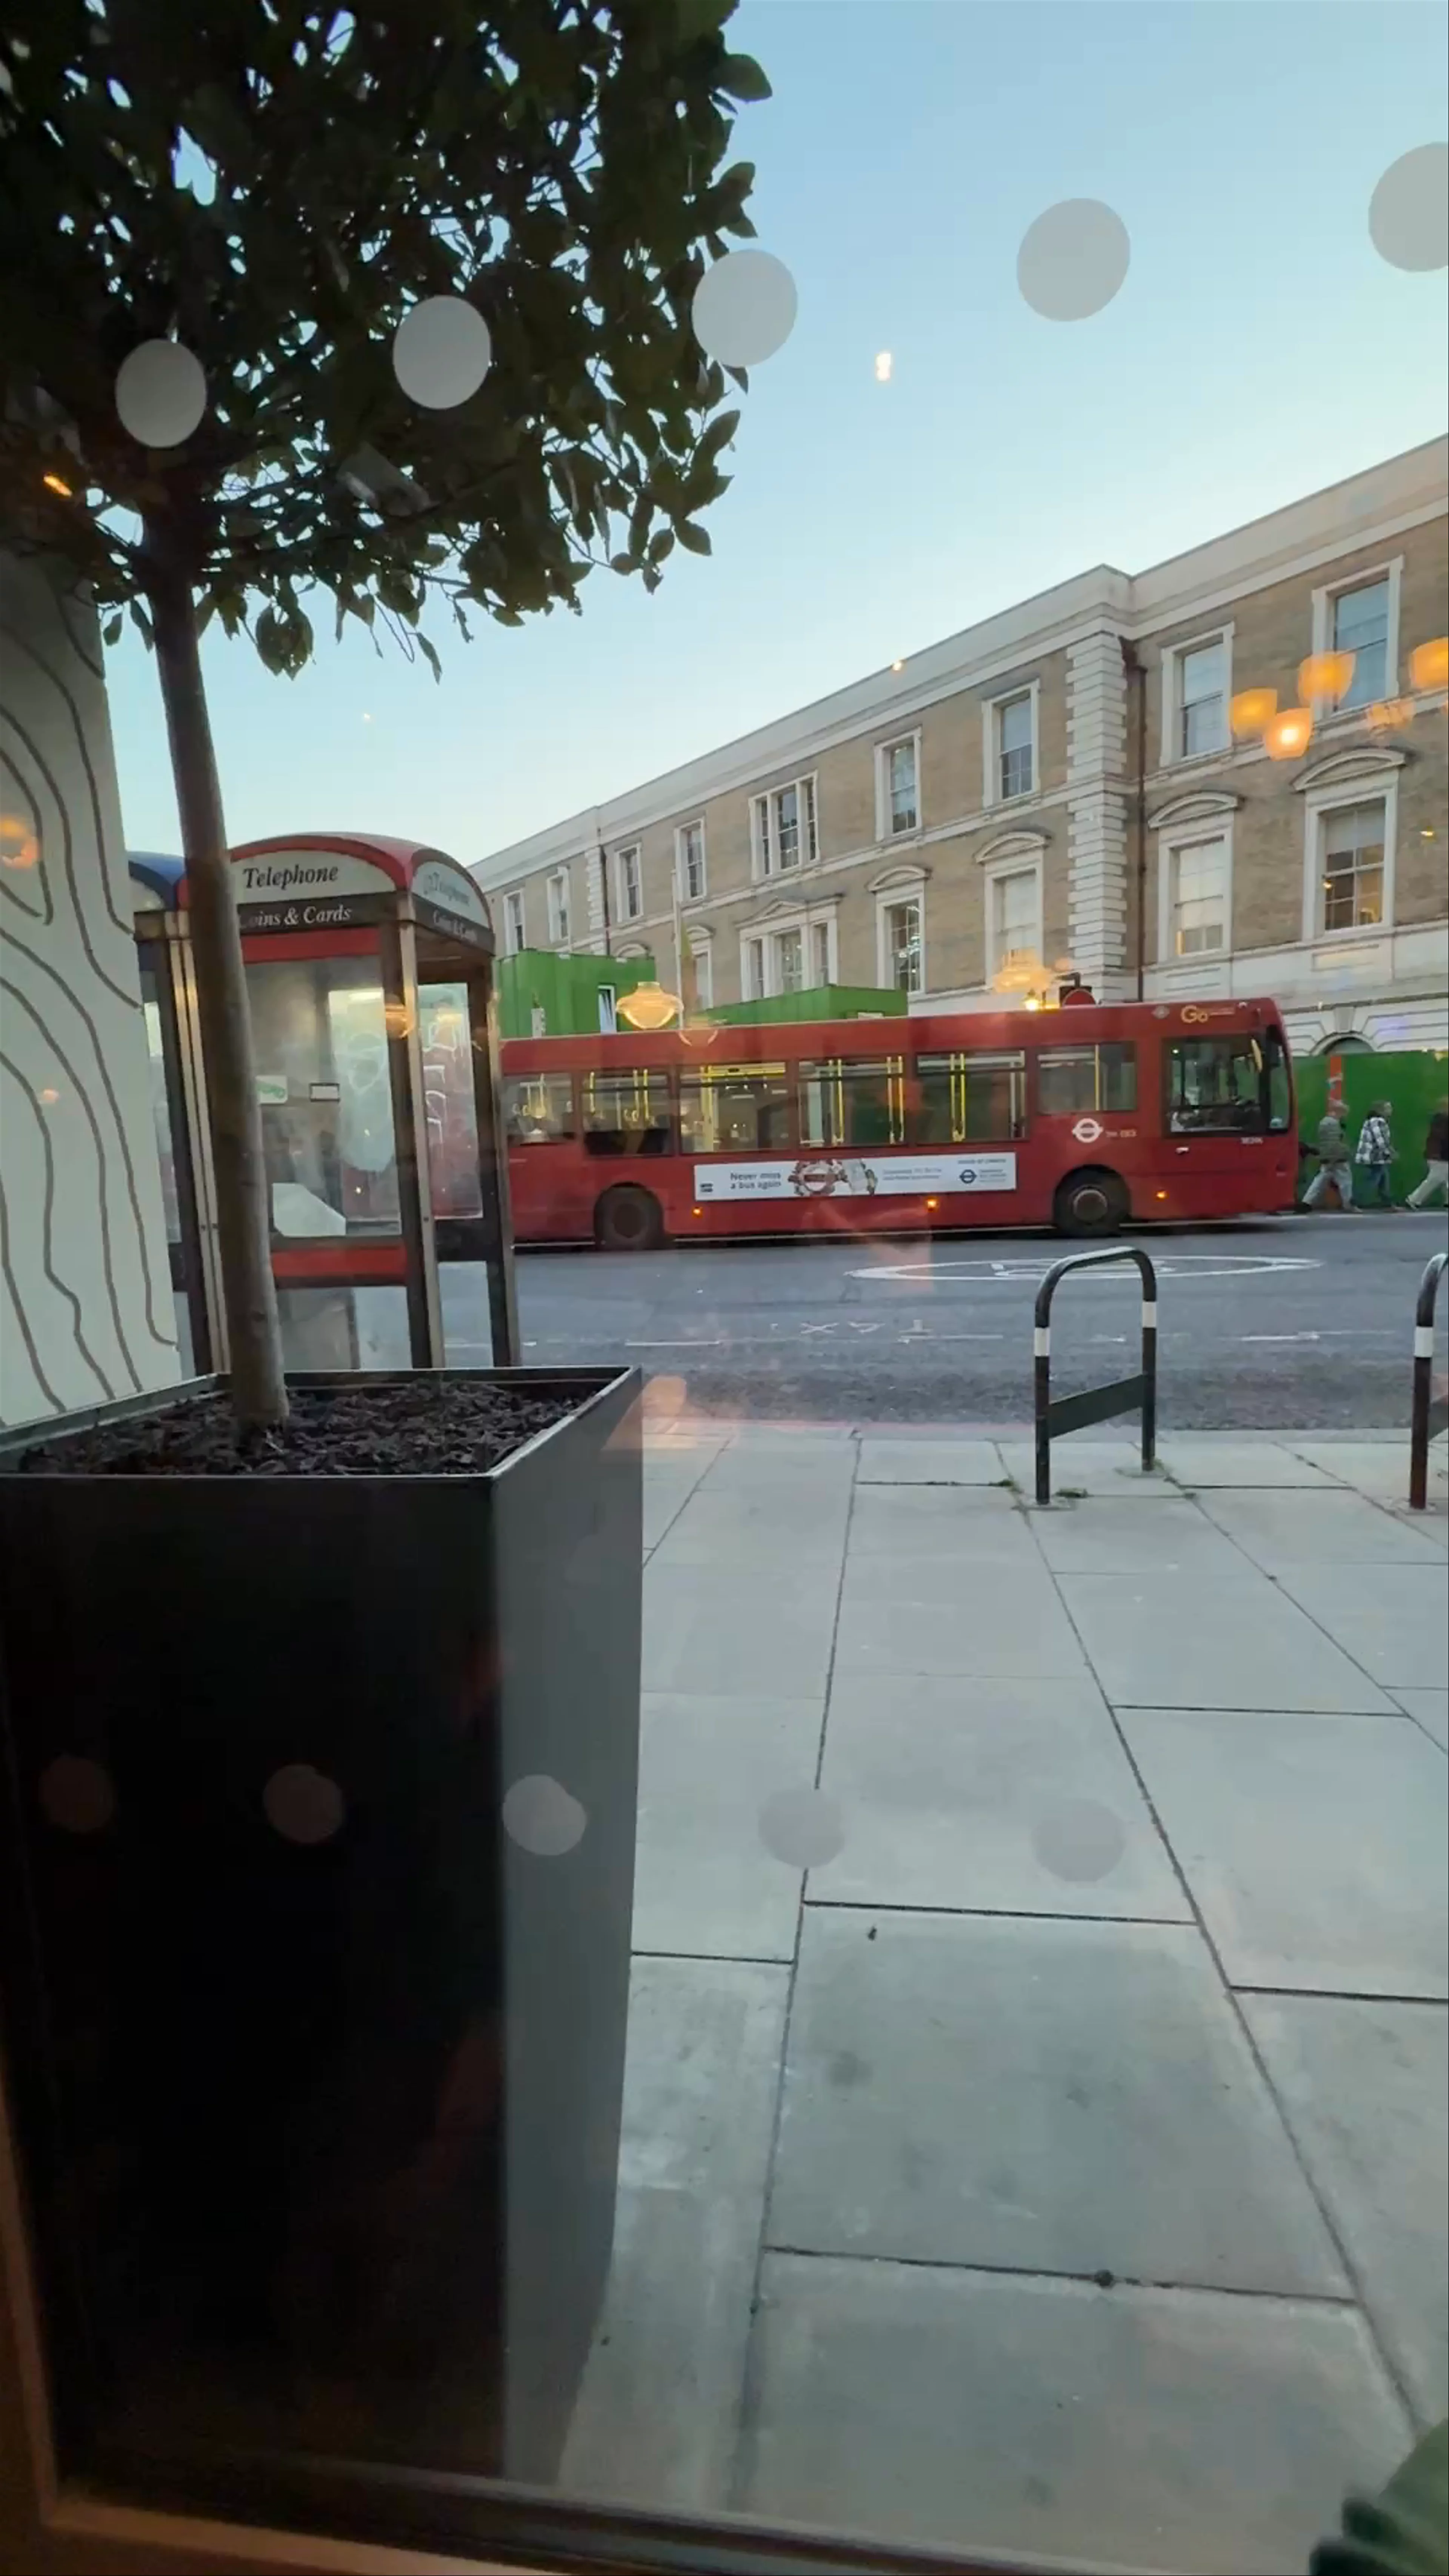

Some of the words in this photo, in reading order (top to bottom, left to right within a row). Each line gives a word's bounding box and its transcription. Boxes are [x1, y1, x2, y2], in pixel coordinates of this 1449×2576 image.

[243, 864, 338, 890] Telephone
[284, 907, 299, 925] &
[303, 904, 352, 924] Cards
